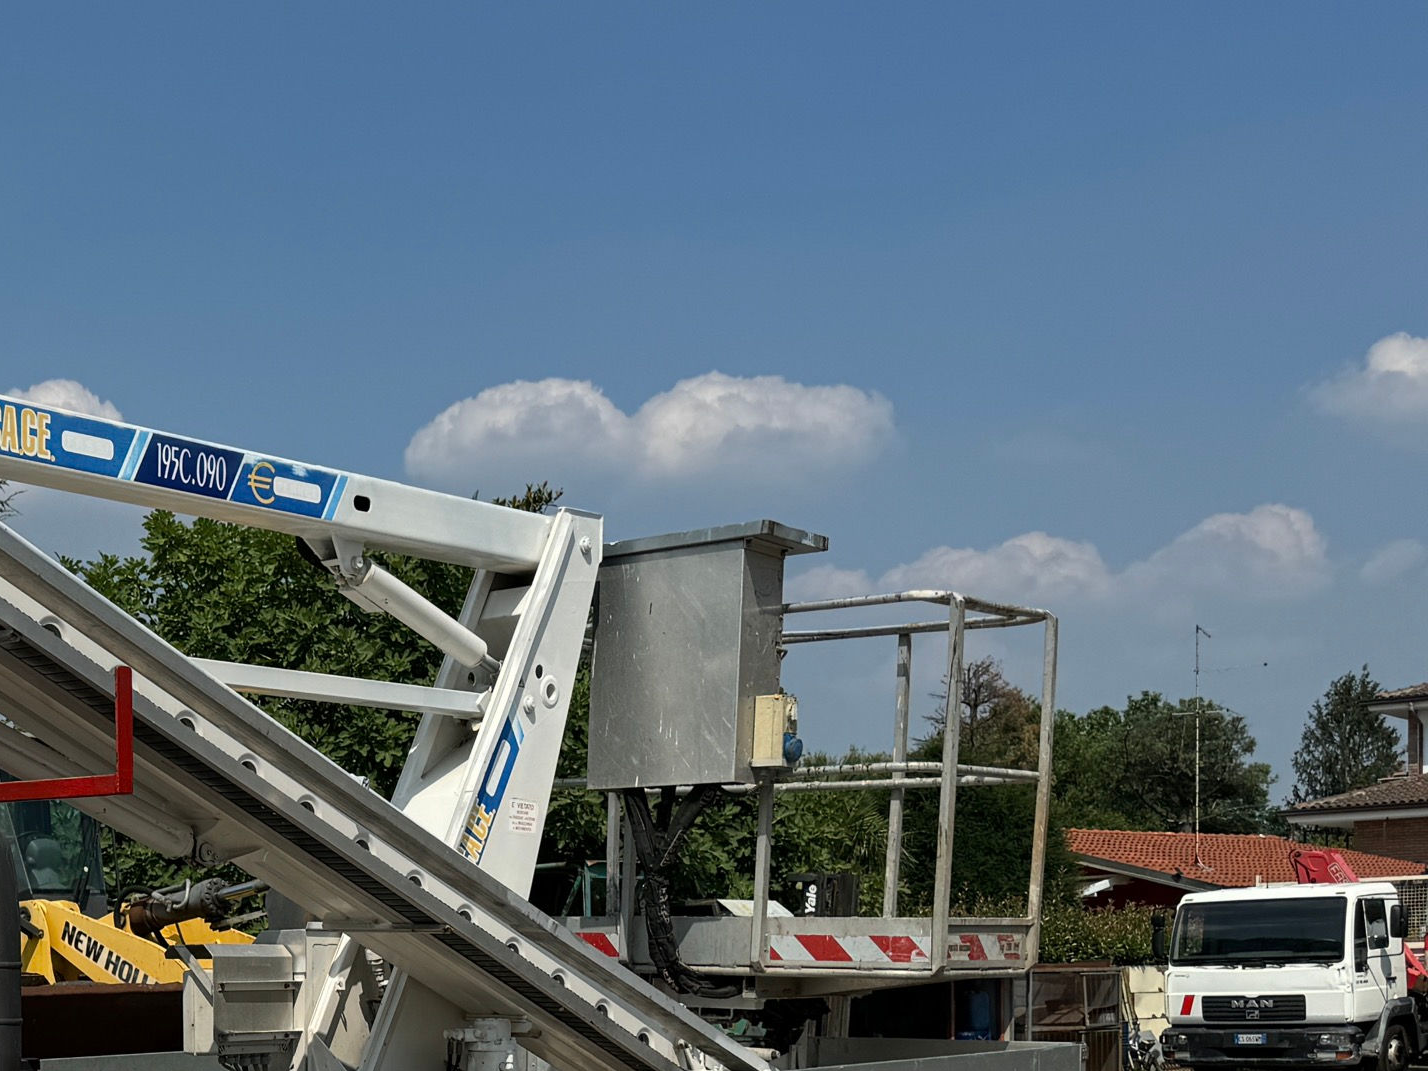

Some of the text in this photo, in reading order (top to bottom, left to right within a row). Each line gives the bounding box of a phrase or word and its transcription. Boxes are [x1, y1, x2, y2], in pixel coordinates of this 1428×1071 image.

[804, 884, 817, 914] Yale
[61, 920, 107, 964] NEW
[1231, 999, 1274, 1009] MAN
